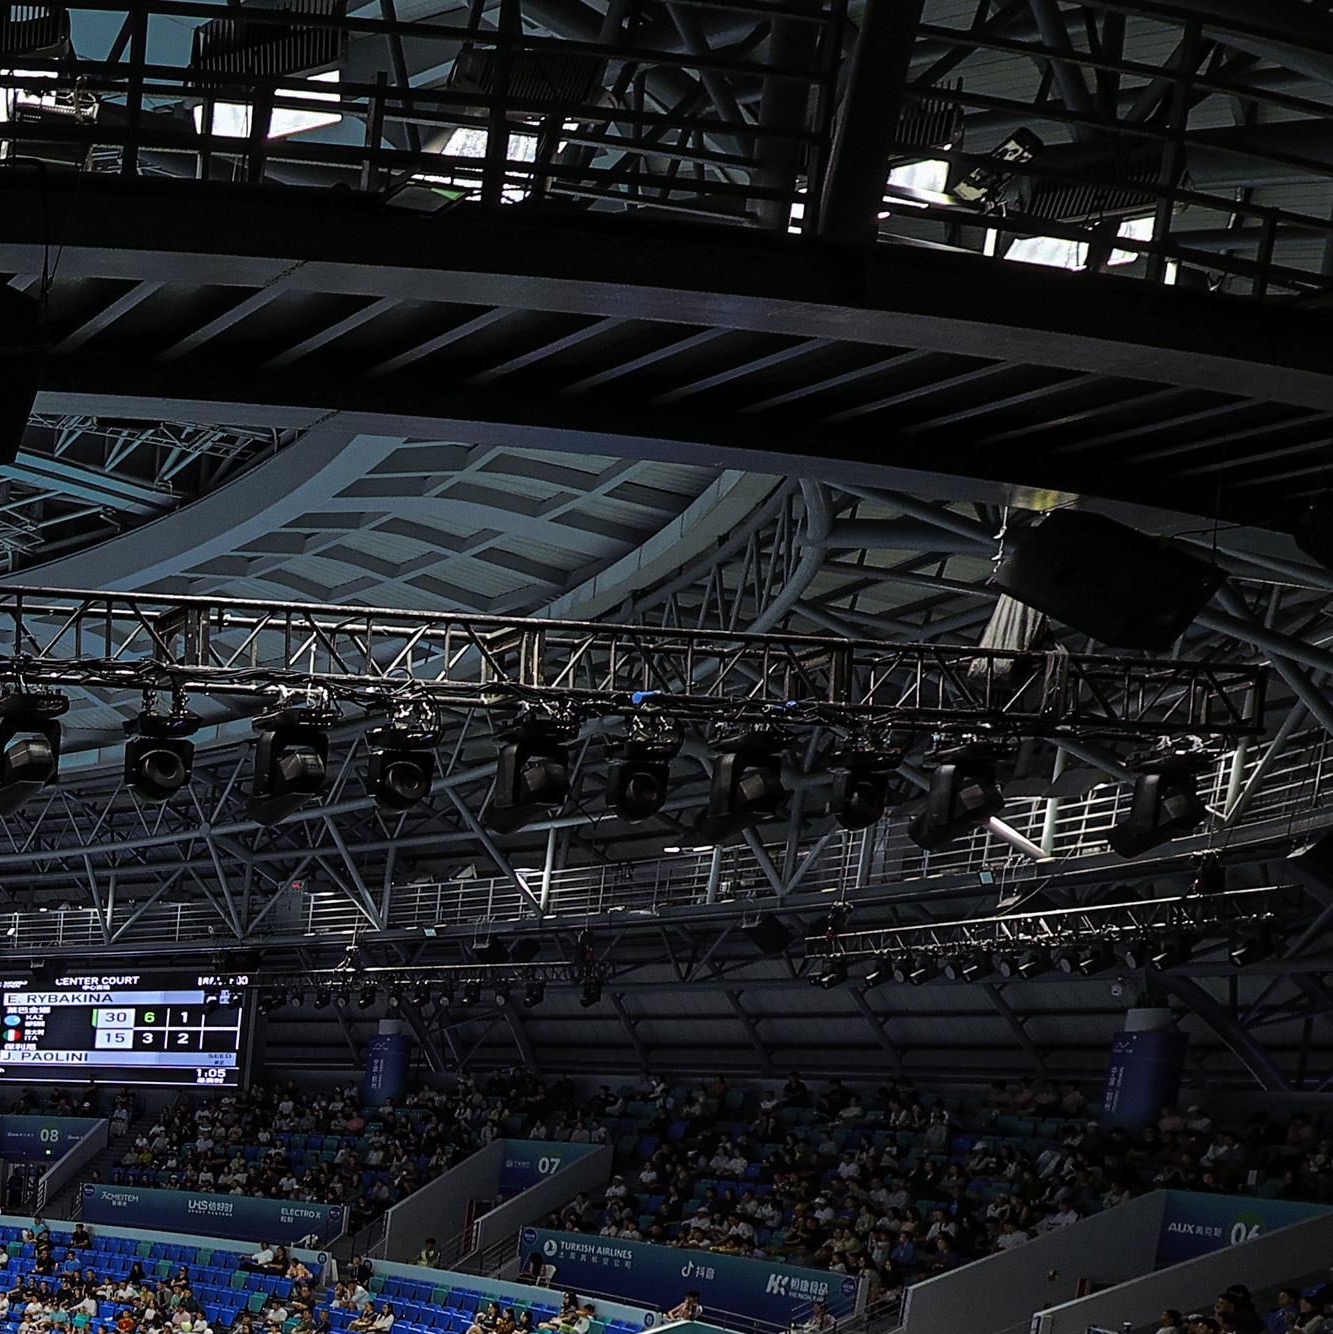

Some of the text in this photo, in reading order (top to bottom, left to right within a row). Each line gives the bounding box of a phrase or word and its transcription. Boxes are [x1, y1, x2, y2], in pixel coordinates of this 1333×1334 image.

[55, 975, 140, 987] CENTER COURT
[27, 993, 114, 1003] RYBAKINA
[104, 1011, 128, 1023] 30
[143, 1011, 156, 1023] 6
[180, 1011, 189, 1023] 1
[105, 1033, 126, 1043] 15
[142, 1032, 154, 1044] 3
[177, 1032, 190, 1044] 2
[21, 1052, 89, 1062] PAOLINI
[40, 1128, 59, 1142] 08
[538, 1156, 561, 1174] 07
[1167, 1221, 1195, 1234] AUX
[560, 1240, 633, 1260] TURKISH AIRLINES
[695, 1266, 717, 1281] 抖音
